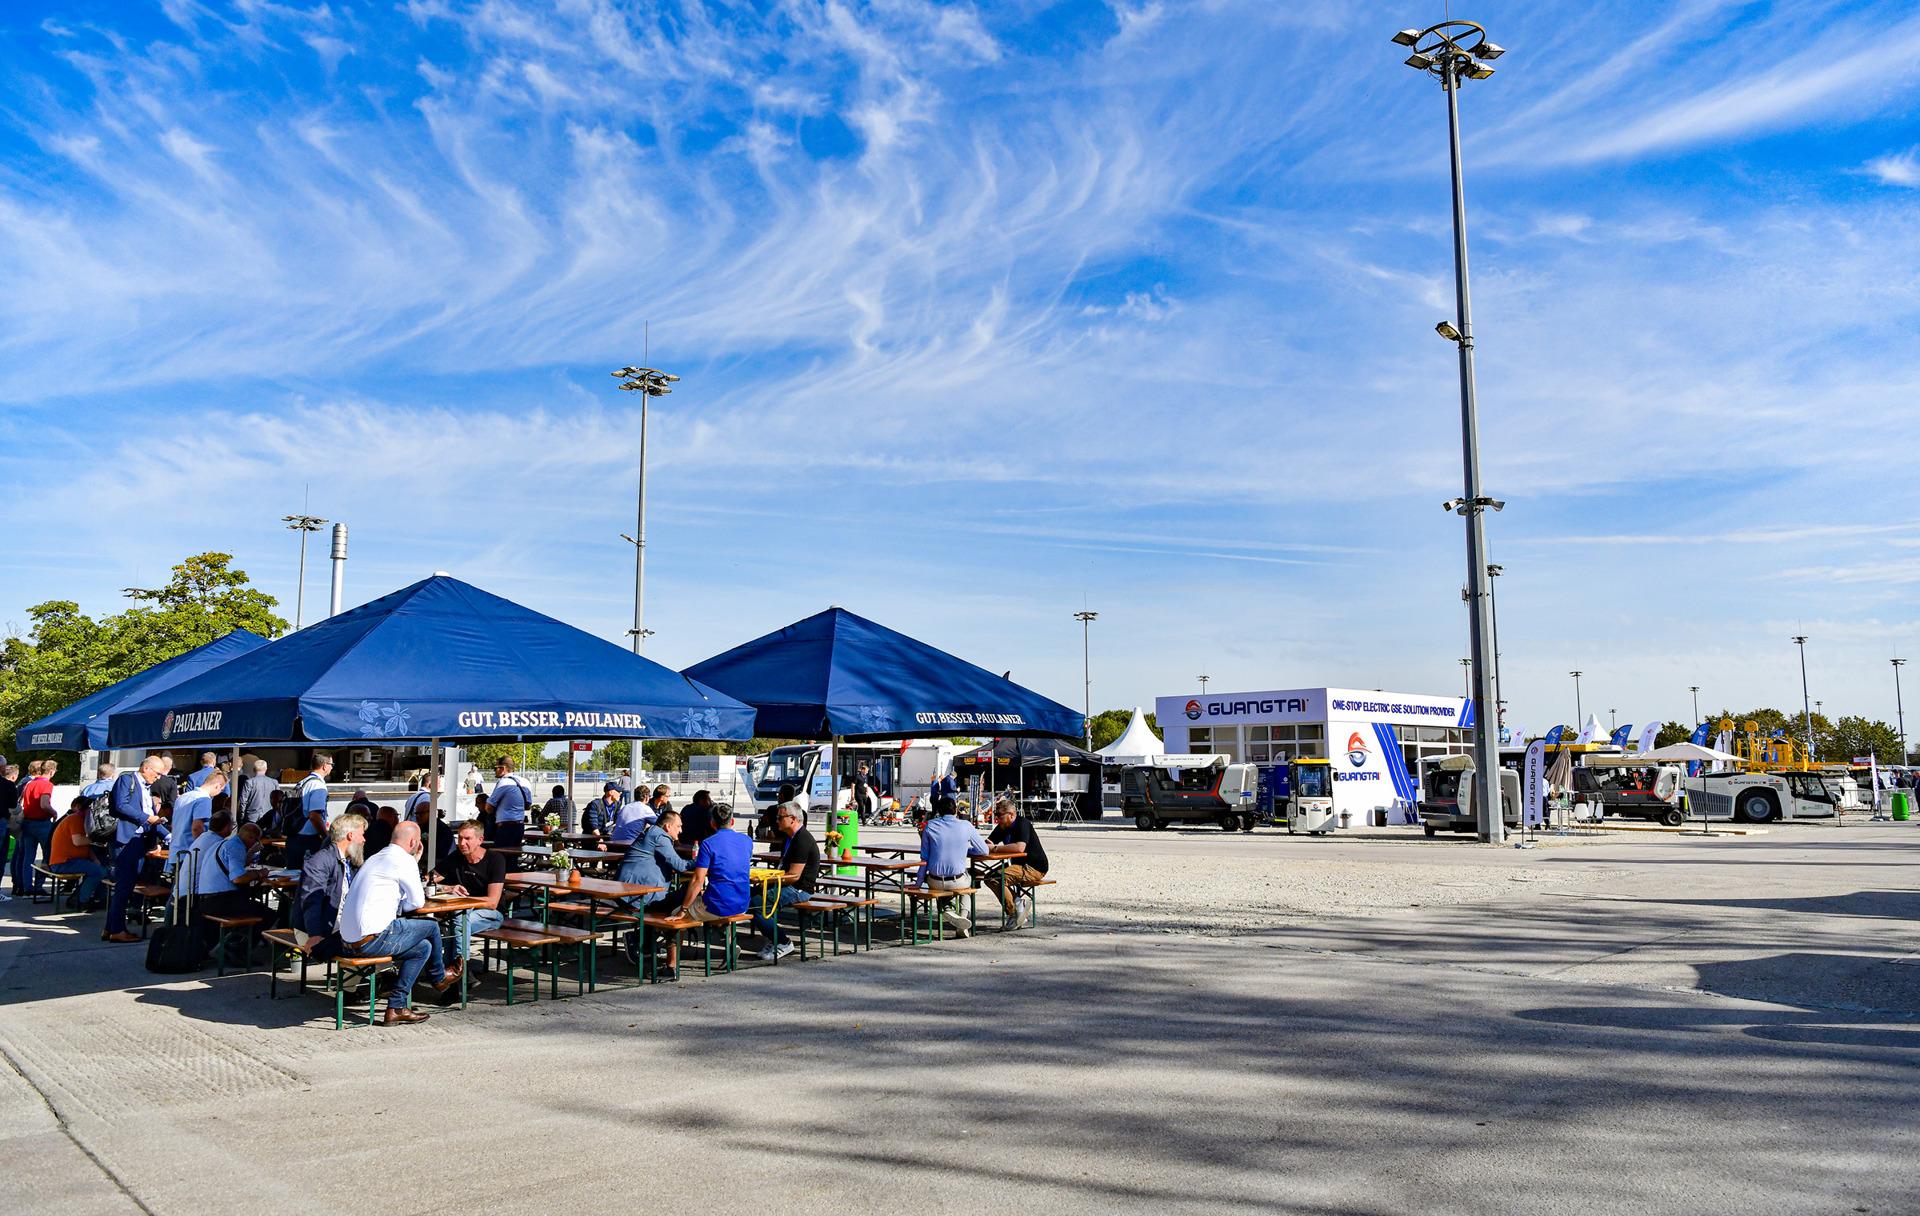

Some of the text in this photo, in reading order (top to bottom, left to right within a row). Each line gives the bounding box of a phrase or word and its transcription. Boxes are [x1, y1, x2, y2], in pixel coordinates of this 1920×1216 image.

[1208, 699, 1306, 715] GUANGTAI
[1332, 700, 1455, 717] ONE-STOP ELECTRIC GSE SOLUTION PROVIDER
[173, 711, 222, 733] PAULANER
[458, 711, 646, 730] GUT, BESSER, PAULANER.
[1338, 771, 1380, 782] GUANGTAI
